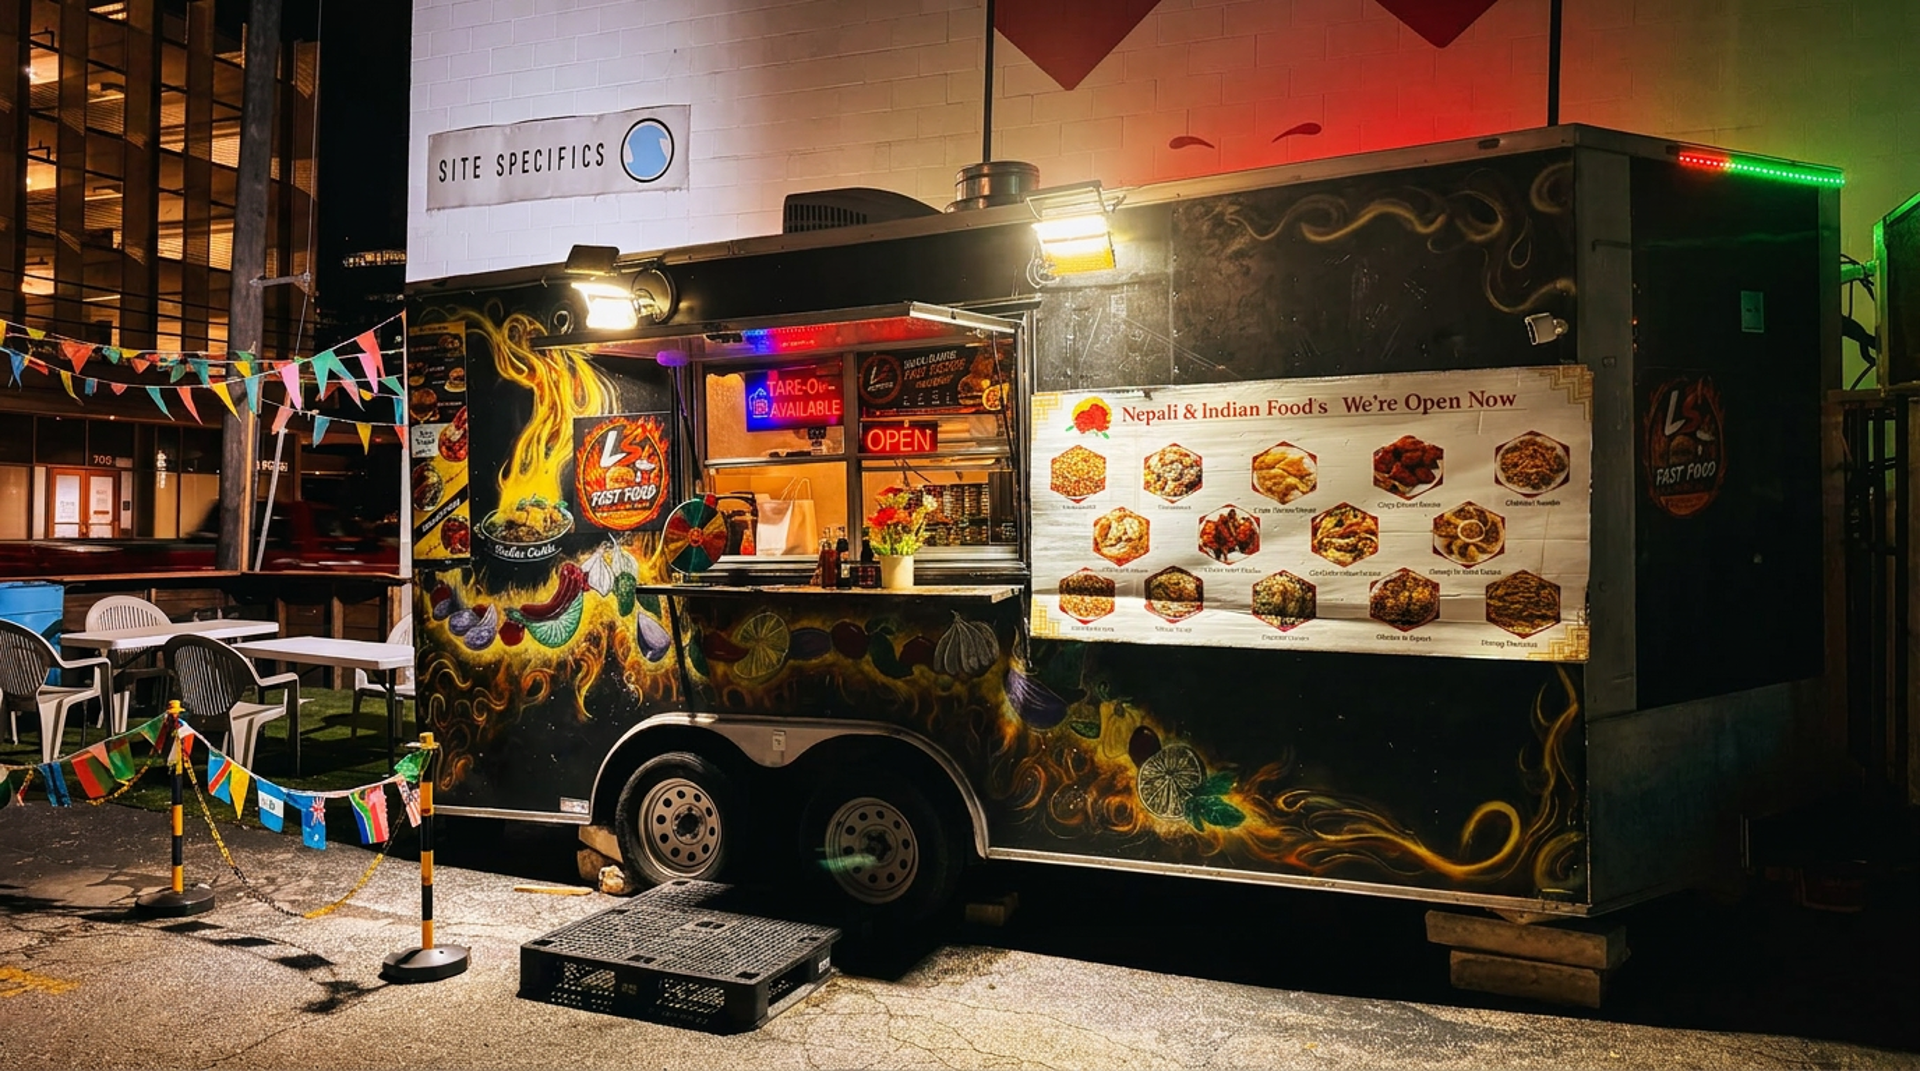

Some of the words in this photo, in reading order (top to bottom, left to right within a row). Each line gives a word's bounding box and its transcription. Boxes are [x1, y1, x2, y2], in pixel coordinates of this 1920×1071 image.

[438, 155, 482, 183] SITE
[496, 142, 605, 177] SPECIFICS
[769, 399, 842, 418] AVAILABLE
[1122, 403, 1178, 426] Nepali
[1183, 402, 1199, 420] &
[1202, 401, 1261, 419] Indian
[1342, 395, 1398, 413] We're
[1404, 392, 1462, 415] Open
[1468, 389, 1517, 409] Now
[867, 427, 932, 453] OPEN
[1655, 464, 1685, 487] FAST
[591, 488, 622, 507] FAST
